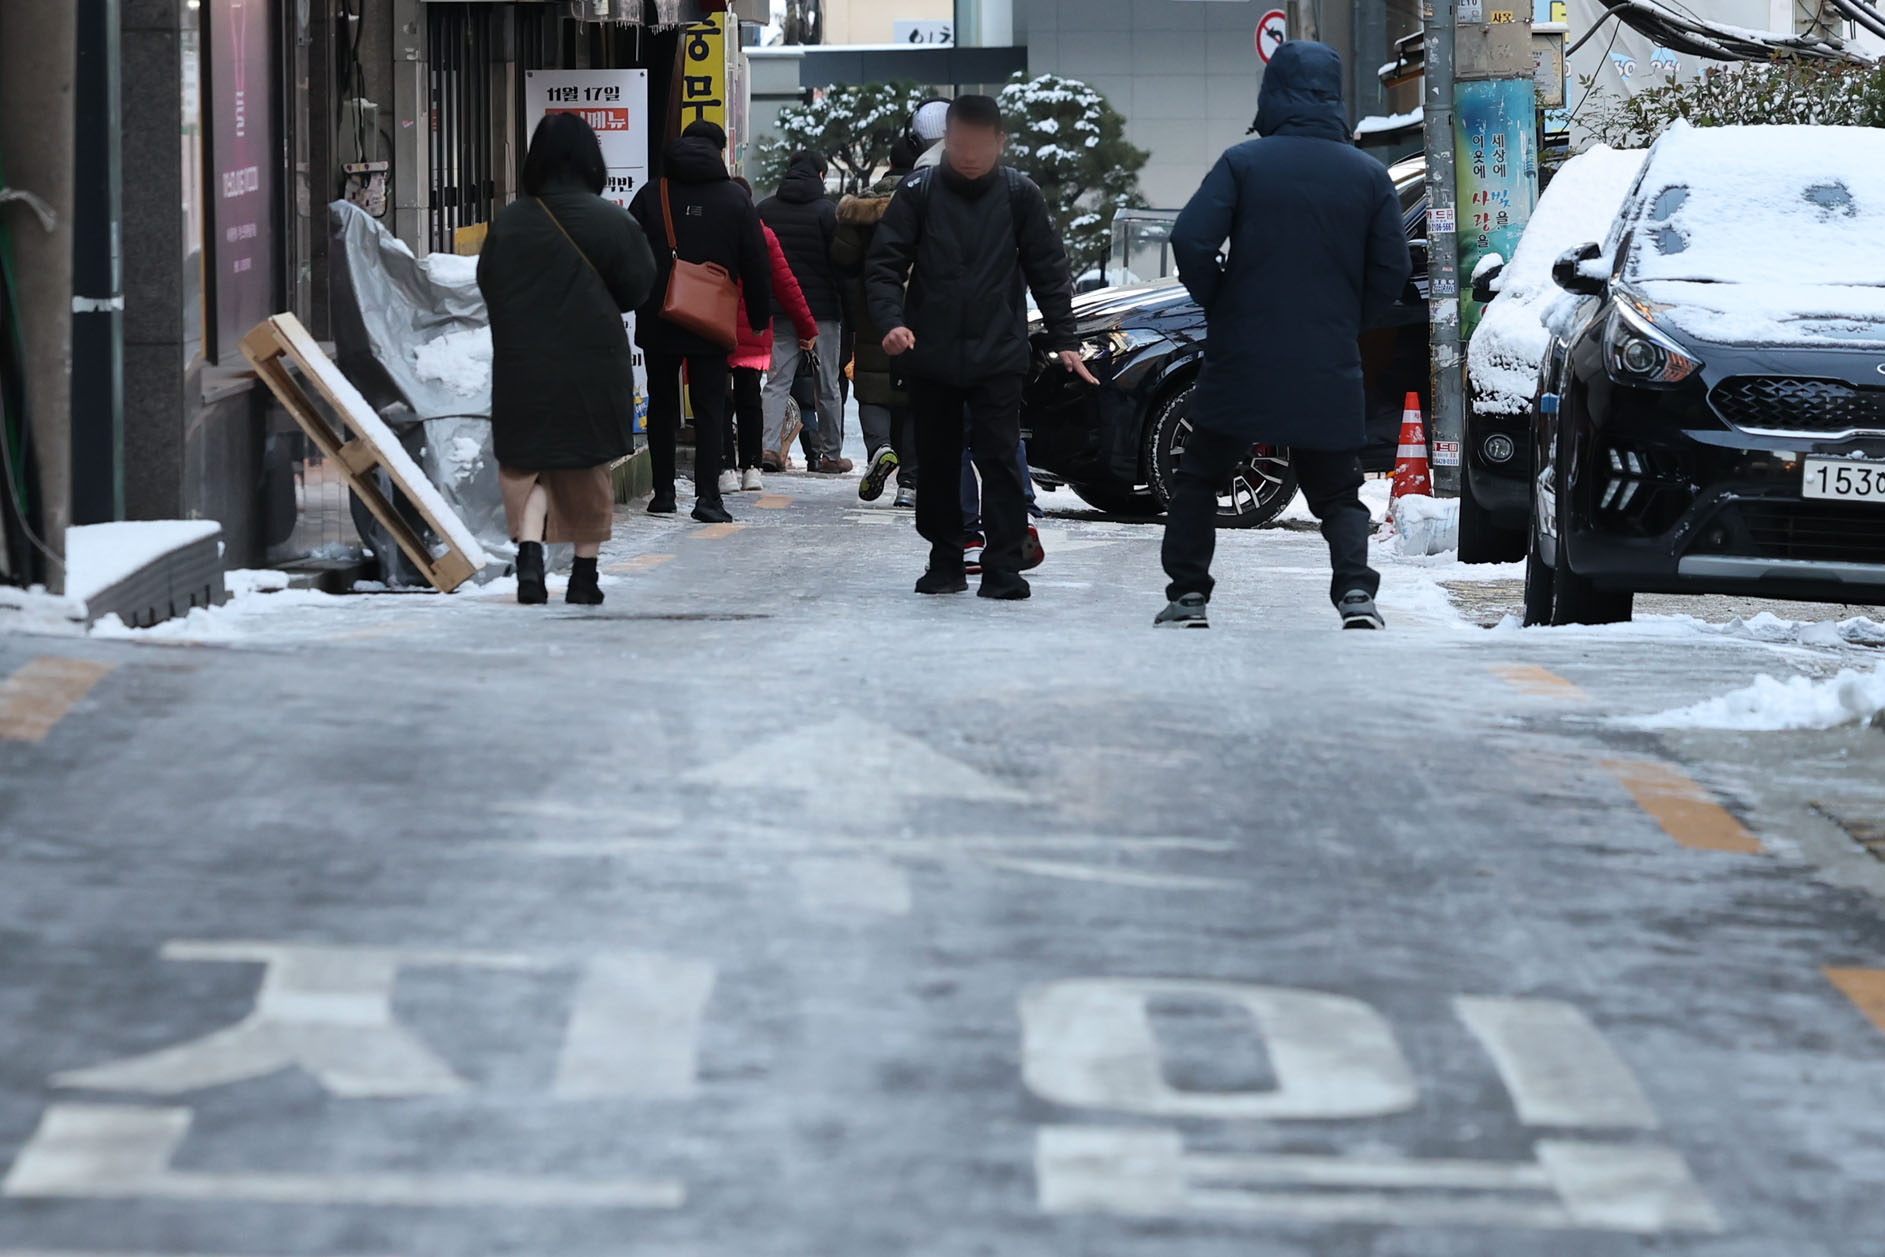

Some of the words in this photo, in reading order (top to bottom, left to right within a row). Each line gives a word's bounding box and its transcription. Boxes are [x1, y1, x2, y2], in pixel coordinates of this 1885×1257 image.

[547, 86, 579, 102] 11월
[584, 86, 620, 102] 17일
[1472, 135, 1486, 179] 이웃에
[1491, 134, 1506, 178] 세상에
